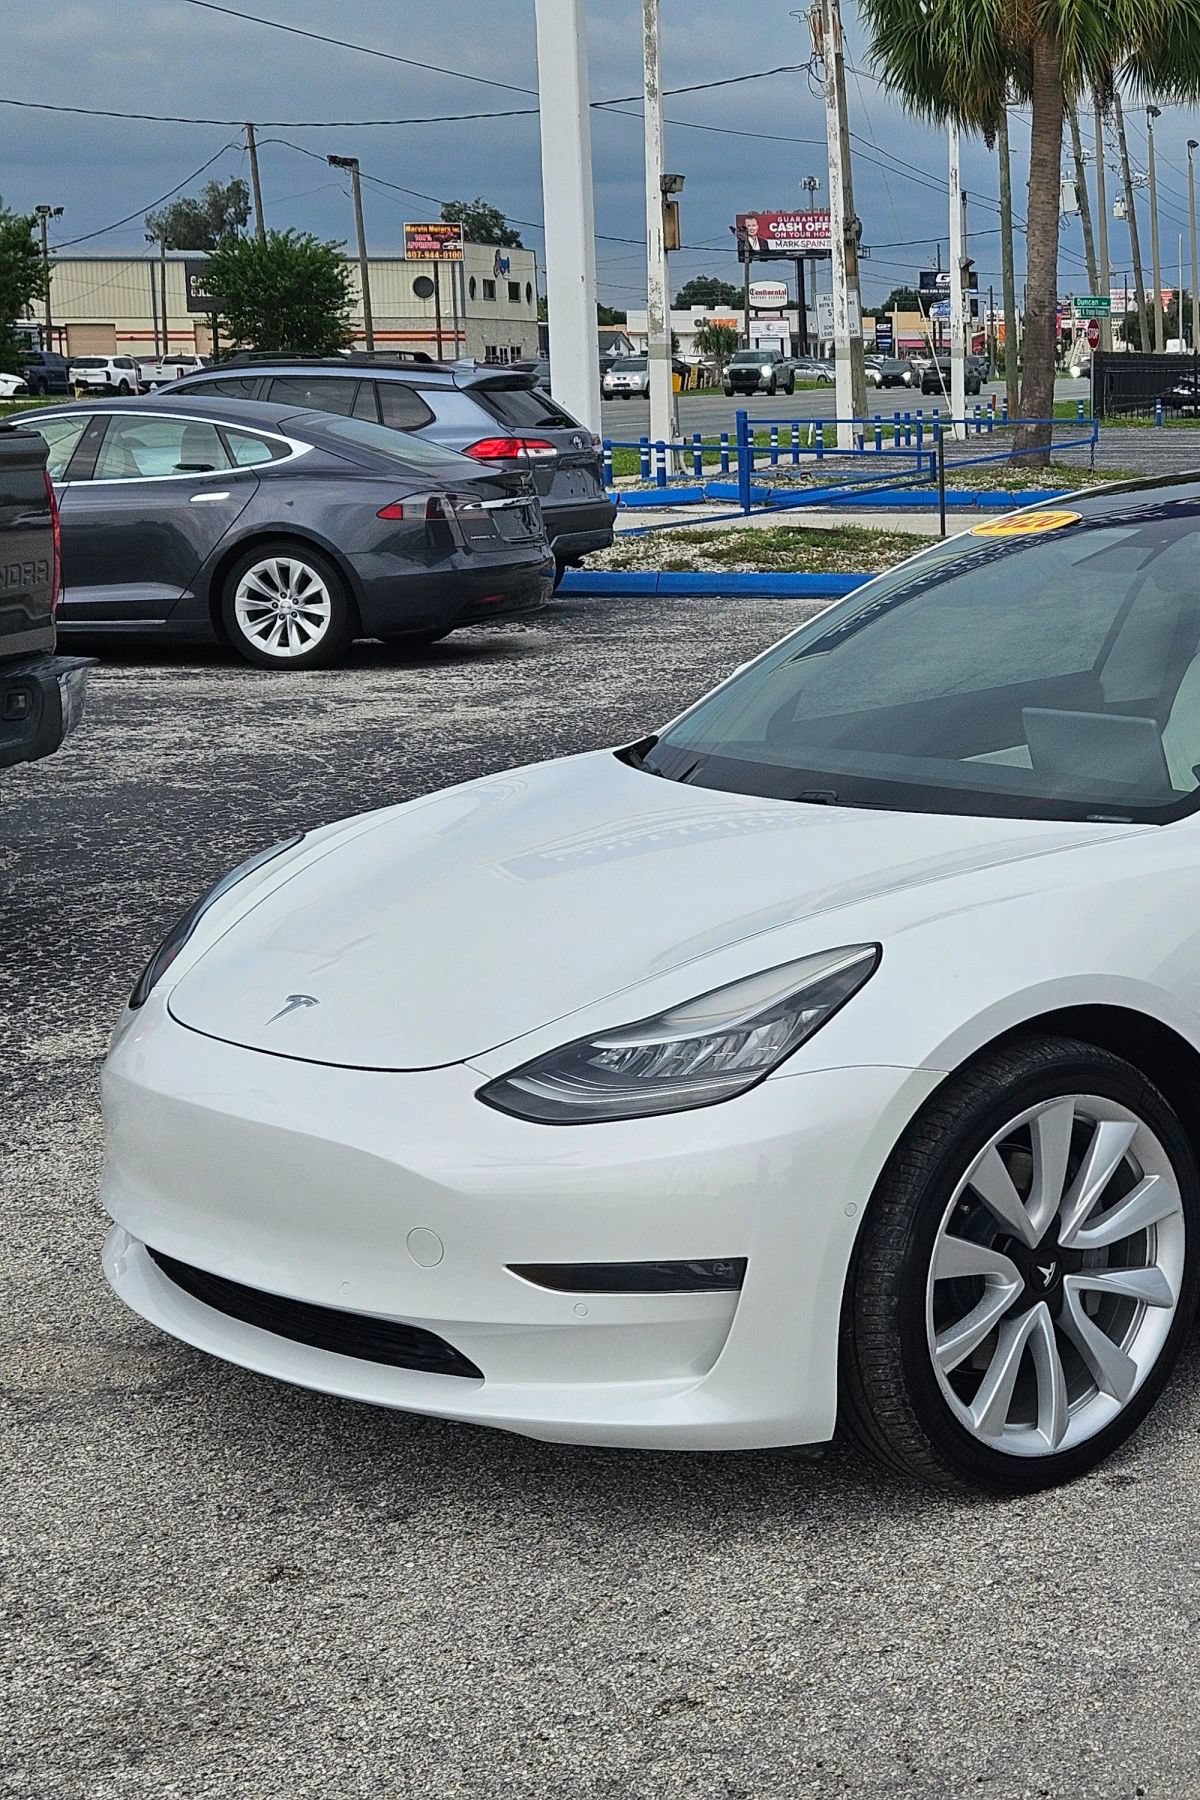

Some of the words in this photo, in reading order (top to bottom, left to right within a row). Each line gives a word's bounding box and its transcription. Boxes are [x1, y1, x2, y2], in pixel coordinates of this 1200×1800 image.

[769, 222, 803, 232] CASH
[805, 222, 831, 232] OFF
[775, 240, 799, 248] MARK
[800, 240, 826, 248] SPAIN
[407, 250, 462, 259] 407-944-0100
[749, 288, 787, 296] Continental
[1076, 298, 1099, 306] Duncan
[1087, 327, 1099, 339] STOP
